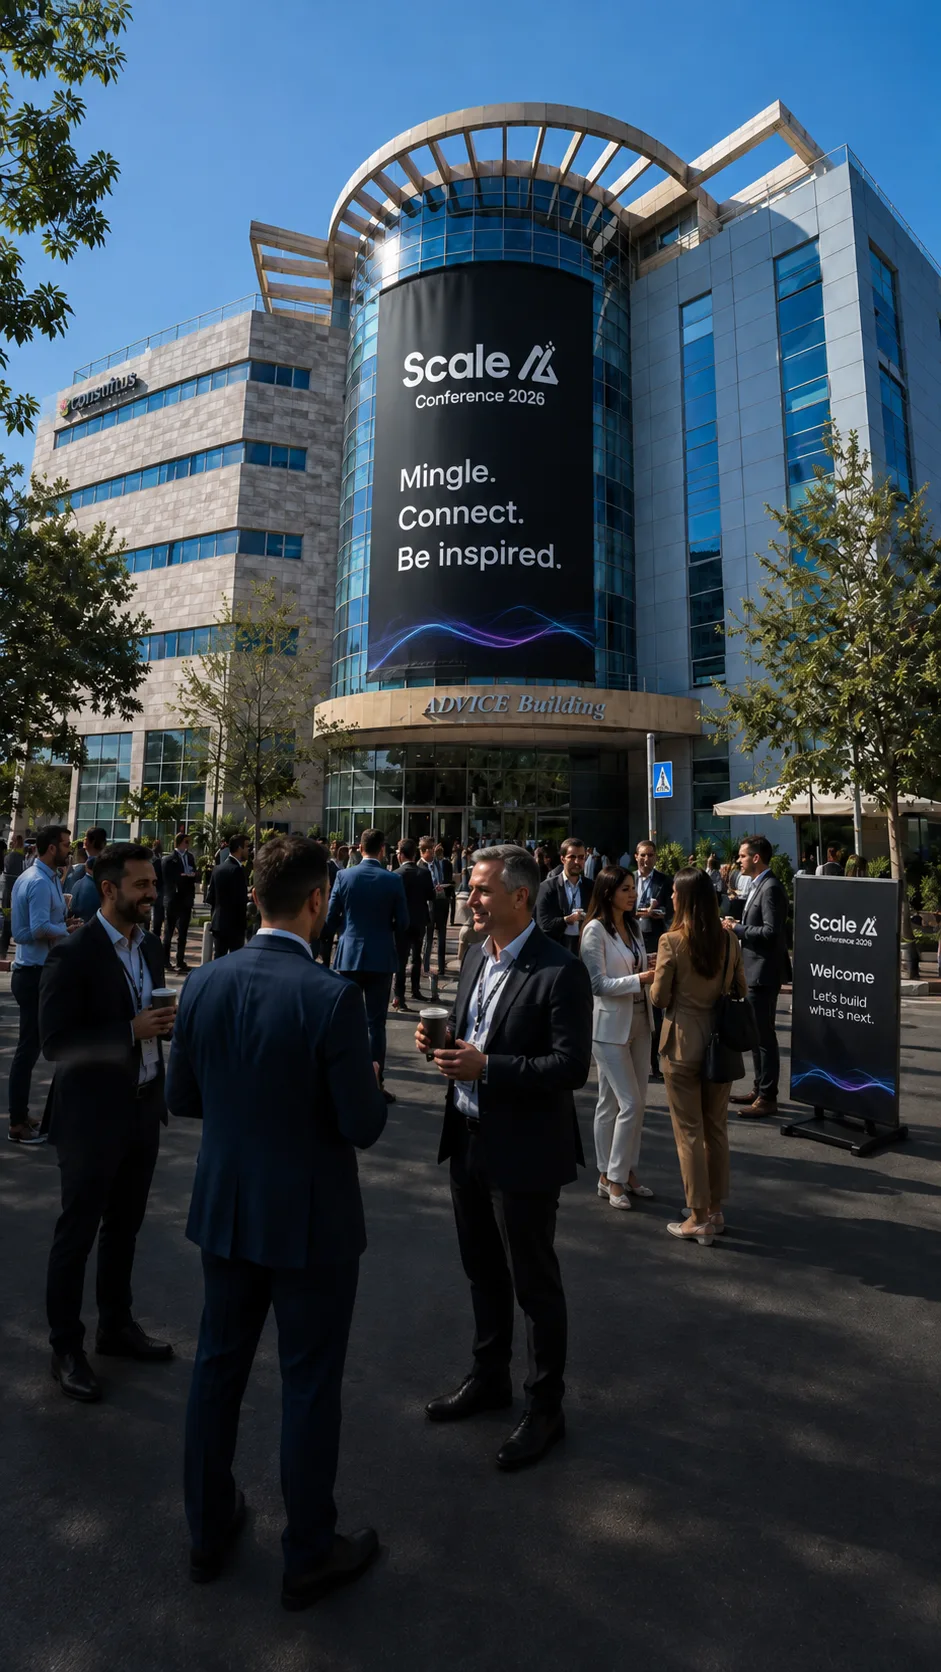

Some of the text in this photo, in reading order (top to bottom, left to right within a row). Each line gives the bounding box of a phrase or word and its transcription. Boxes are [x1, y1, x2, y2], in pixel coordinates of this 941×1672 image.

[402, 343, 510, 388] Scale
[415, 389, 545, 409] Conference 2026
[400, 458, 496, 492] Mingle.
[398, 501, 524, 531] Connect.
[397, 539, 562, 572] Be inspired.
[425, 694, 606, 720] ADVICE Building
[809, 912, 857, 933] Scale
[810, 963, 875, 984] Welcome
[813, 989, 867, 1008] Let's build
[809, 1004, 875, 1025] what's next.
